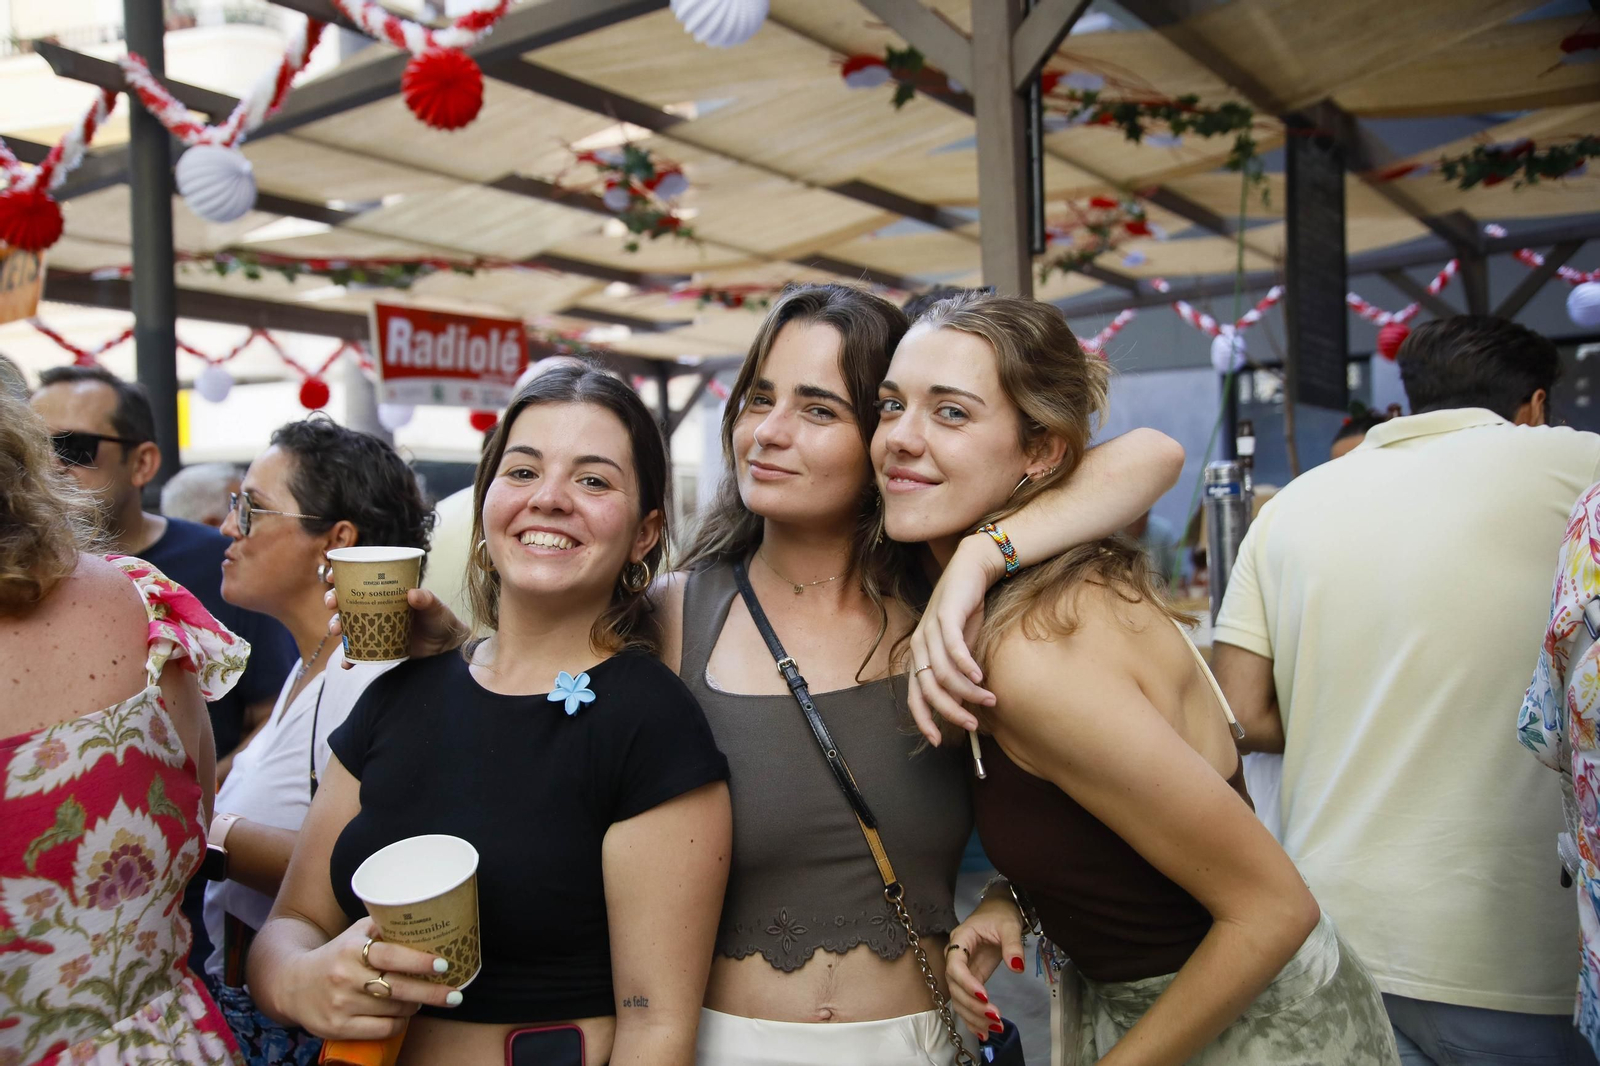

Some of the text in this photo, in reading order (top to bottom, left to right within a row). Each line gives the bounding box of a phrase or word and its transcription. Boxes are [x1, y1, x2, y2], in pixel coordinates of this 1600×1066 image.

[386, 316, 521, 373] Radiolé
[350, 588, 366, 599] Soy
[399, 920, 451, 937] sostenible
[632, 995, 649, 1008] feliz
